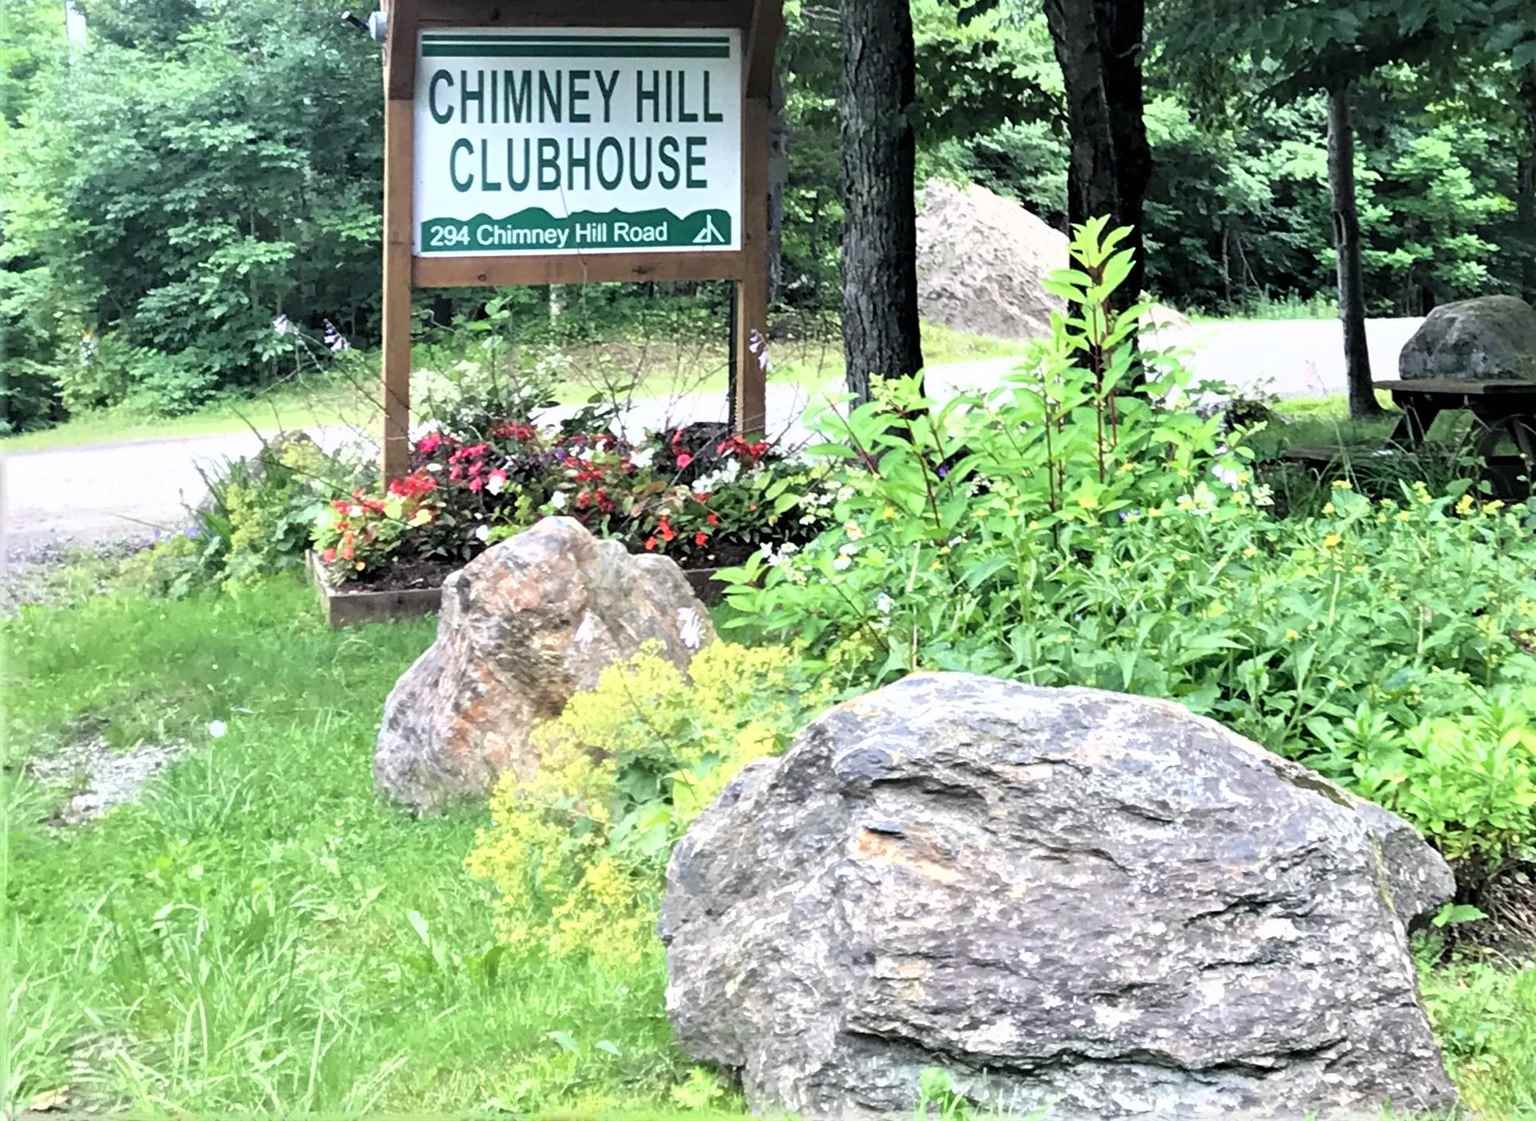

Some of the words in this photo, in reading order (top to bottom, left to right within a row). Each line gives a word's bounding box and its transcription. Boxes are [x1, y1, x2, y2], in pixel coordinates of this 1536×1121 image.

[429, 69, 620, 124] CHIMNEY
[636, 69, 723, 123] HILL
[450, 136, 708, 192] CLUBHOUSE
[429, 225, 470, 246] 294
[476, 224, 569, 249] Chimney
[575, 223, 607, 243] Hill
[613, 221, 668, 242] Road
